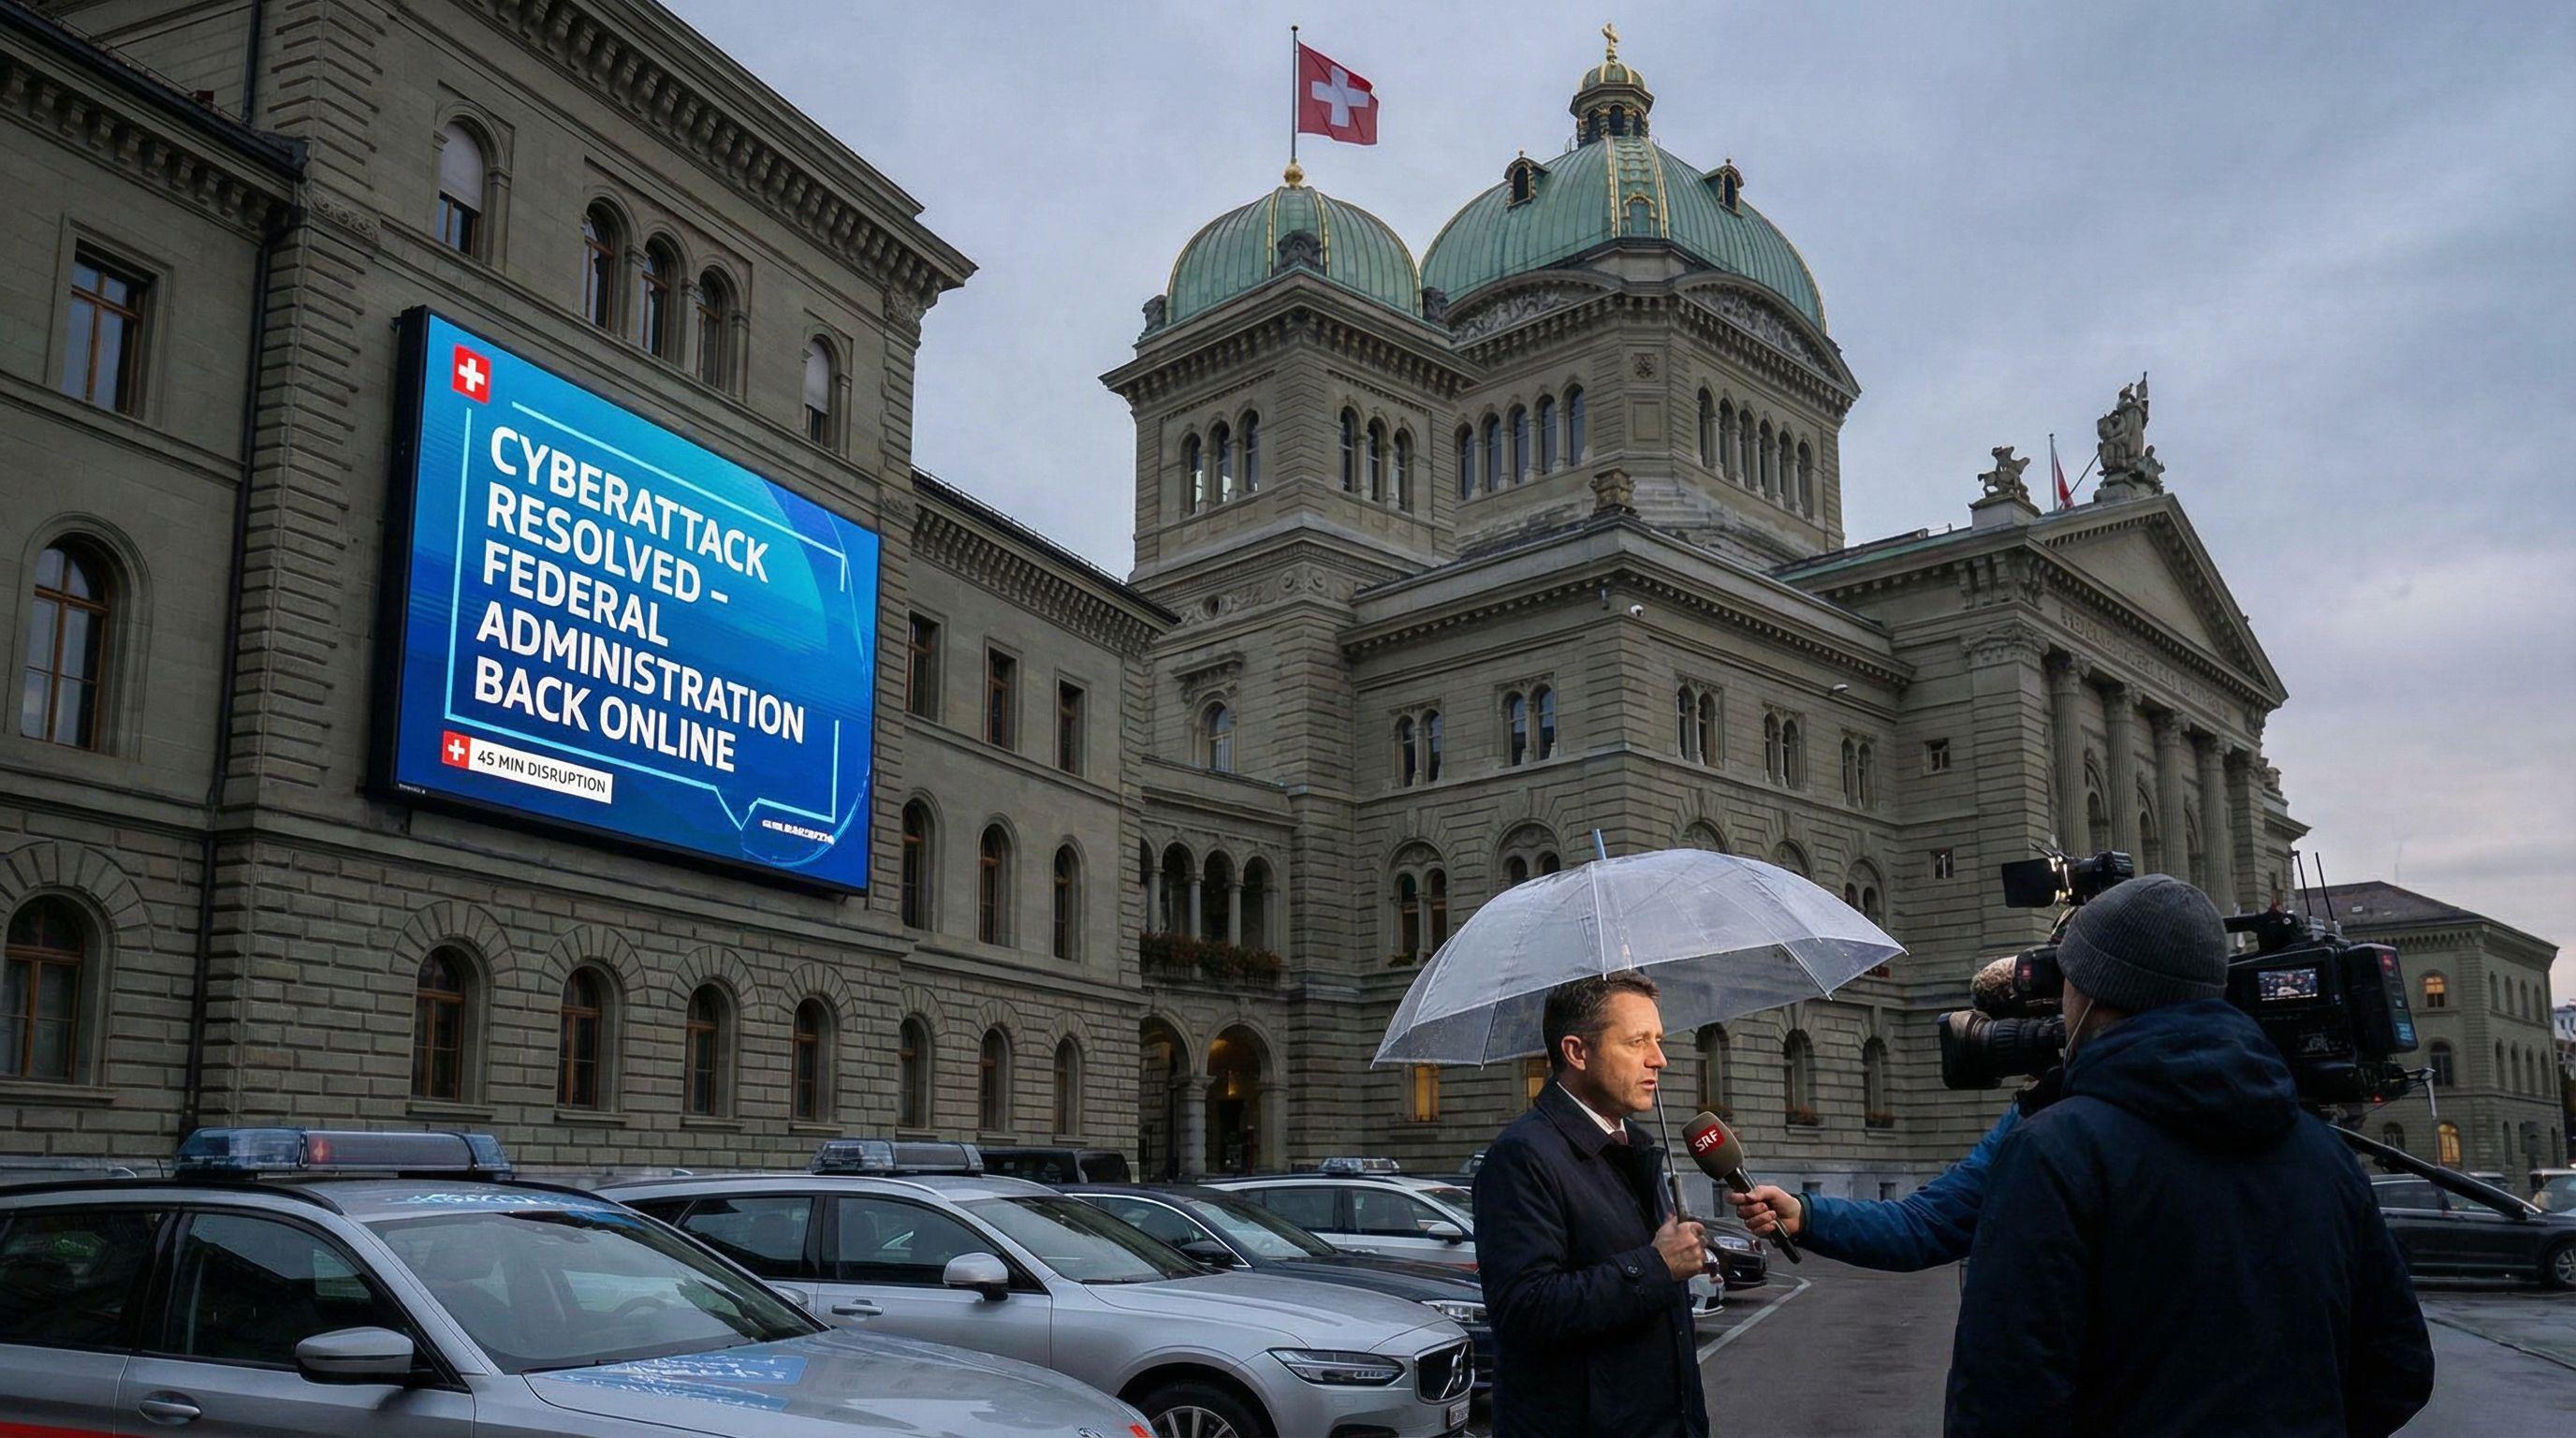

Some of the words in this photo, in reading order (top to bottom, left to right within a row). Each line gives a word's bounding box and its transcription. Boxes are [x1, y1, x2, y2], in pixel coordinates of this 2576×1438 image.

[487, 481, 701, 604] RESOLVED
[490, 426, 768, 583] CYBERATTACK
[483, 539, 668, 647] FEDERAL
[475, 655, 592, 731] BACK
[600, 696, 736, 772] ONLINE
[476, 600, 804, 744] ADMINISTRATION
[498, 755, 524, 773] MIN
[528, 762, 606, 793] DISRUPTION
[1695, 1129, 1719, 1152] SRF
